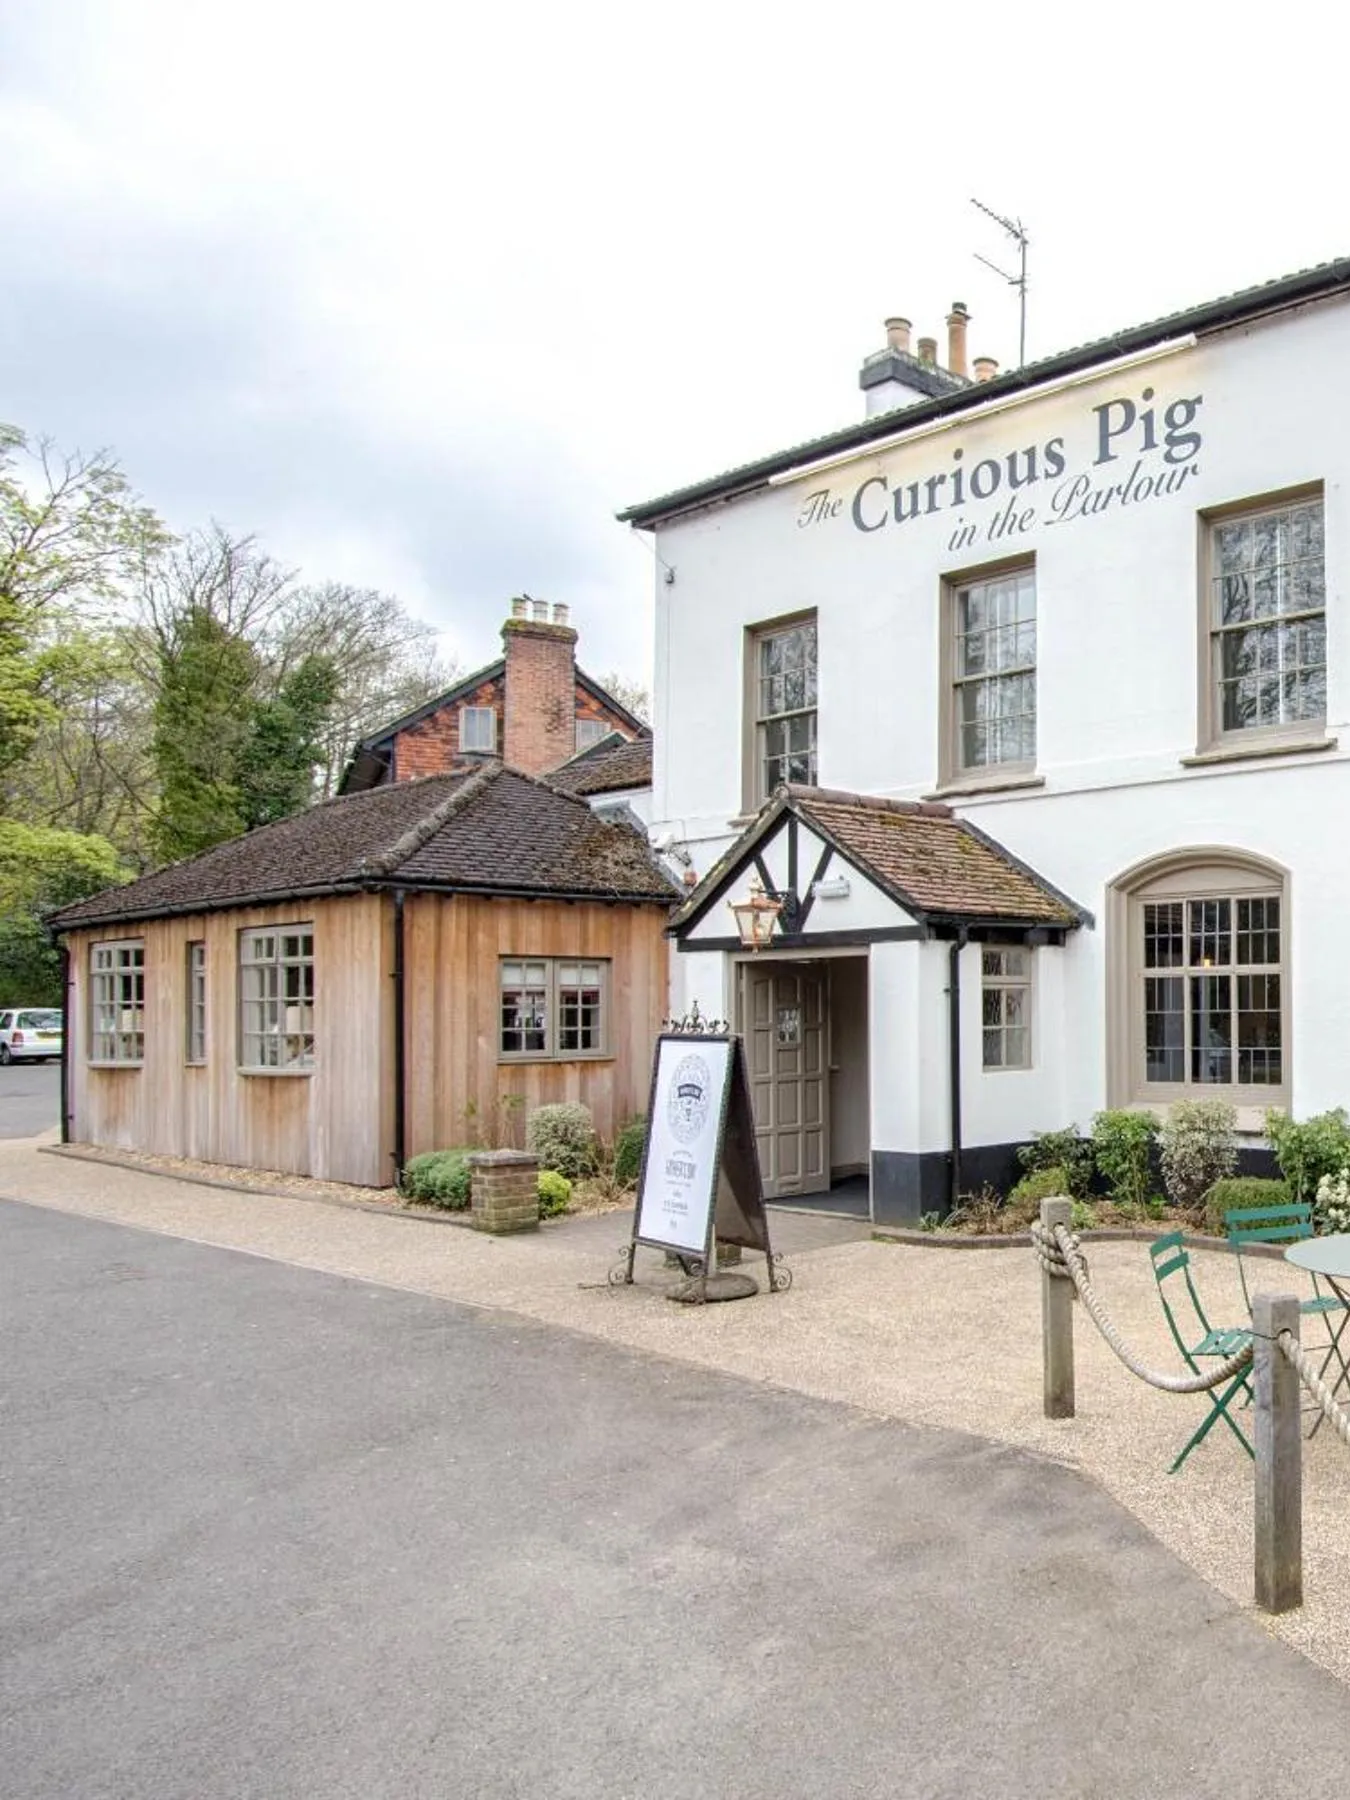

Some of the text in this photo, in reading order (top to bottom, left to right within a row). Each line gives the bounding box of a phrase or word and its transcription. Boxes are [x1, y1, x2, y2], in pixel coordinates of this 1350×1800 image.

[797, 387, 1203, 532] The Curious Pig
[948, 459, 1200, 551] in the Parlour
